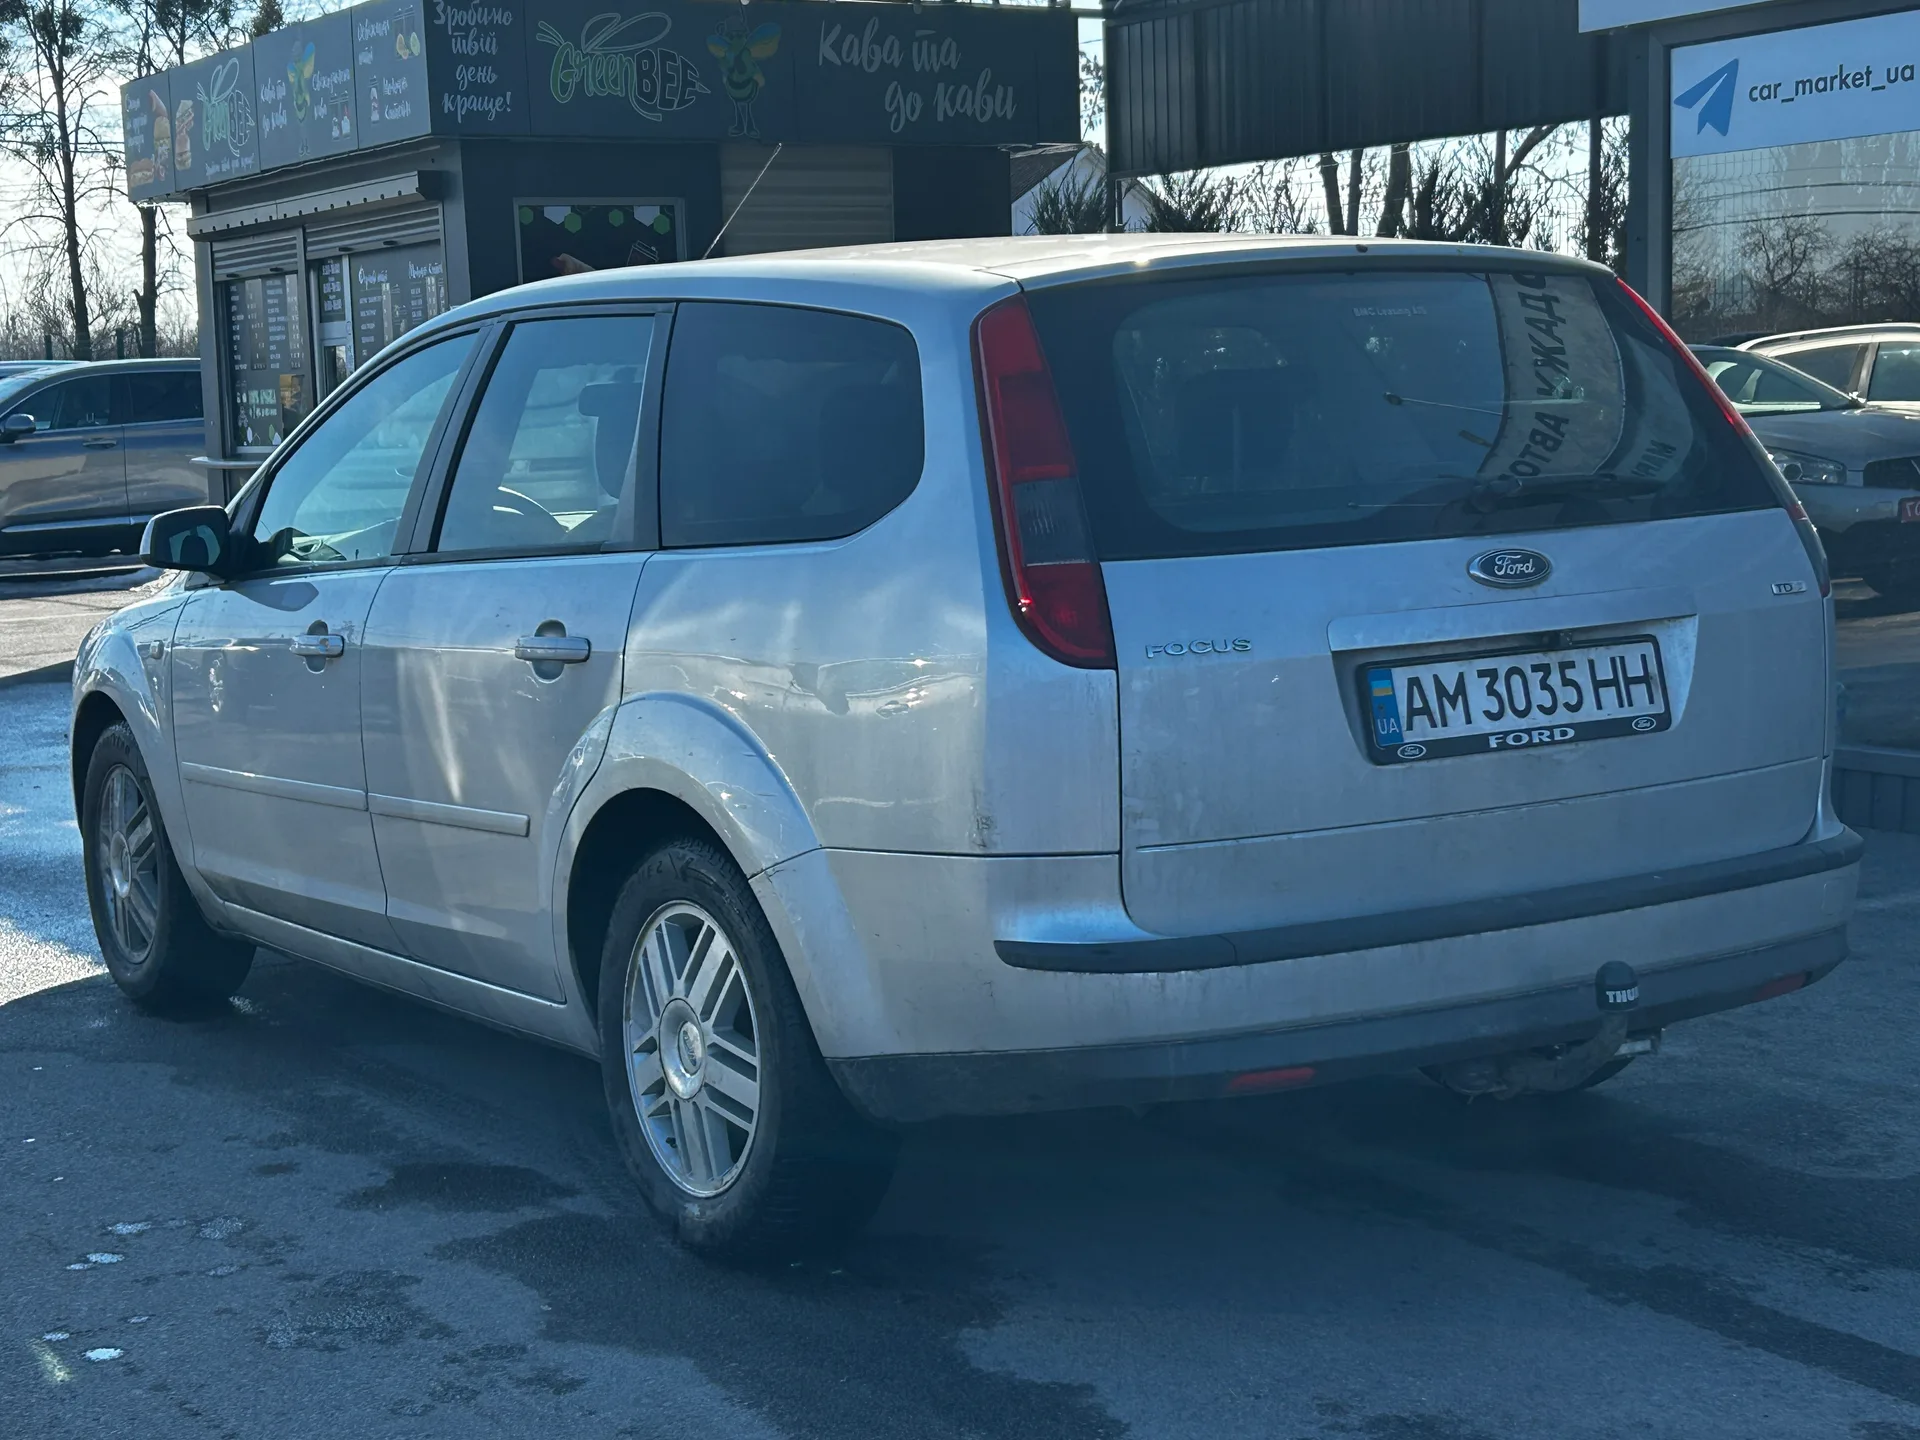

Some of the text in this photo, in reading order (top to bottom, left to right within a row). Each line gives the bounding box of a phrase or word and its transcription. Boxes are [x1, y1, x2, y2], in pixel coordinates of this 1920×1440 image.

[451, 28, 499, 56] твій
[818, 16, 962, 73] Кава та
[456, 63, 498, 91] день
[1748, 63, 1915, 103] car_market_ua
[441, 91, 512, 124] краще!
[884, 67, 1018, 133] до кави
[1493, 554, 1536, 576] Ford
[1144, 637, 1254, 660] FOCUS
[1377, 717, 1399, 735] UA
[1488, 727, 1576, 748] FORD
